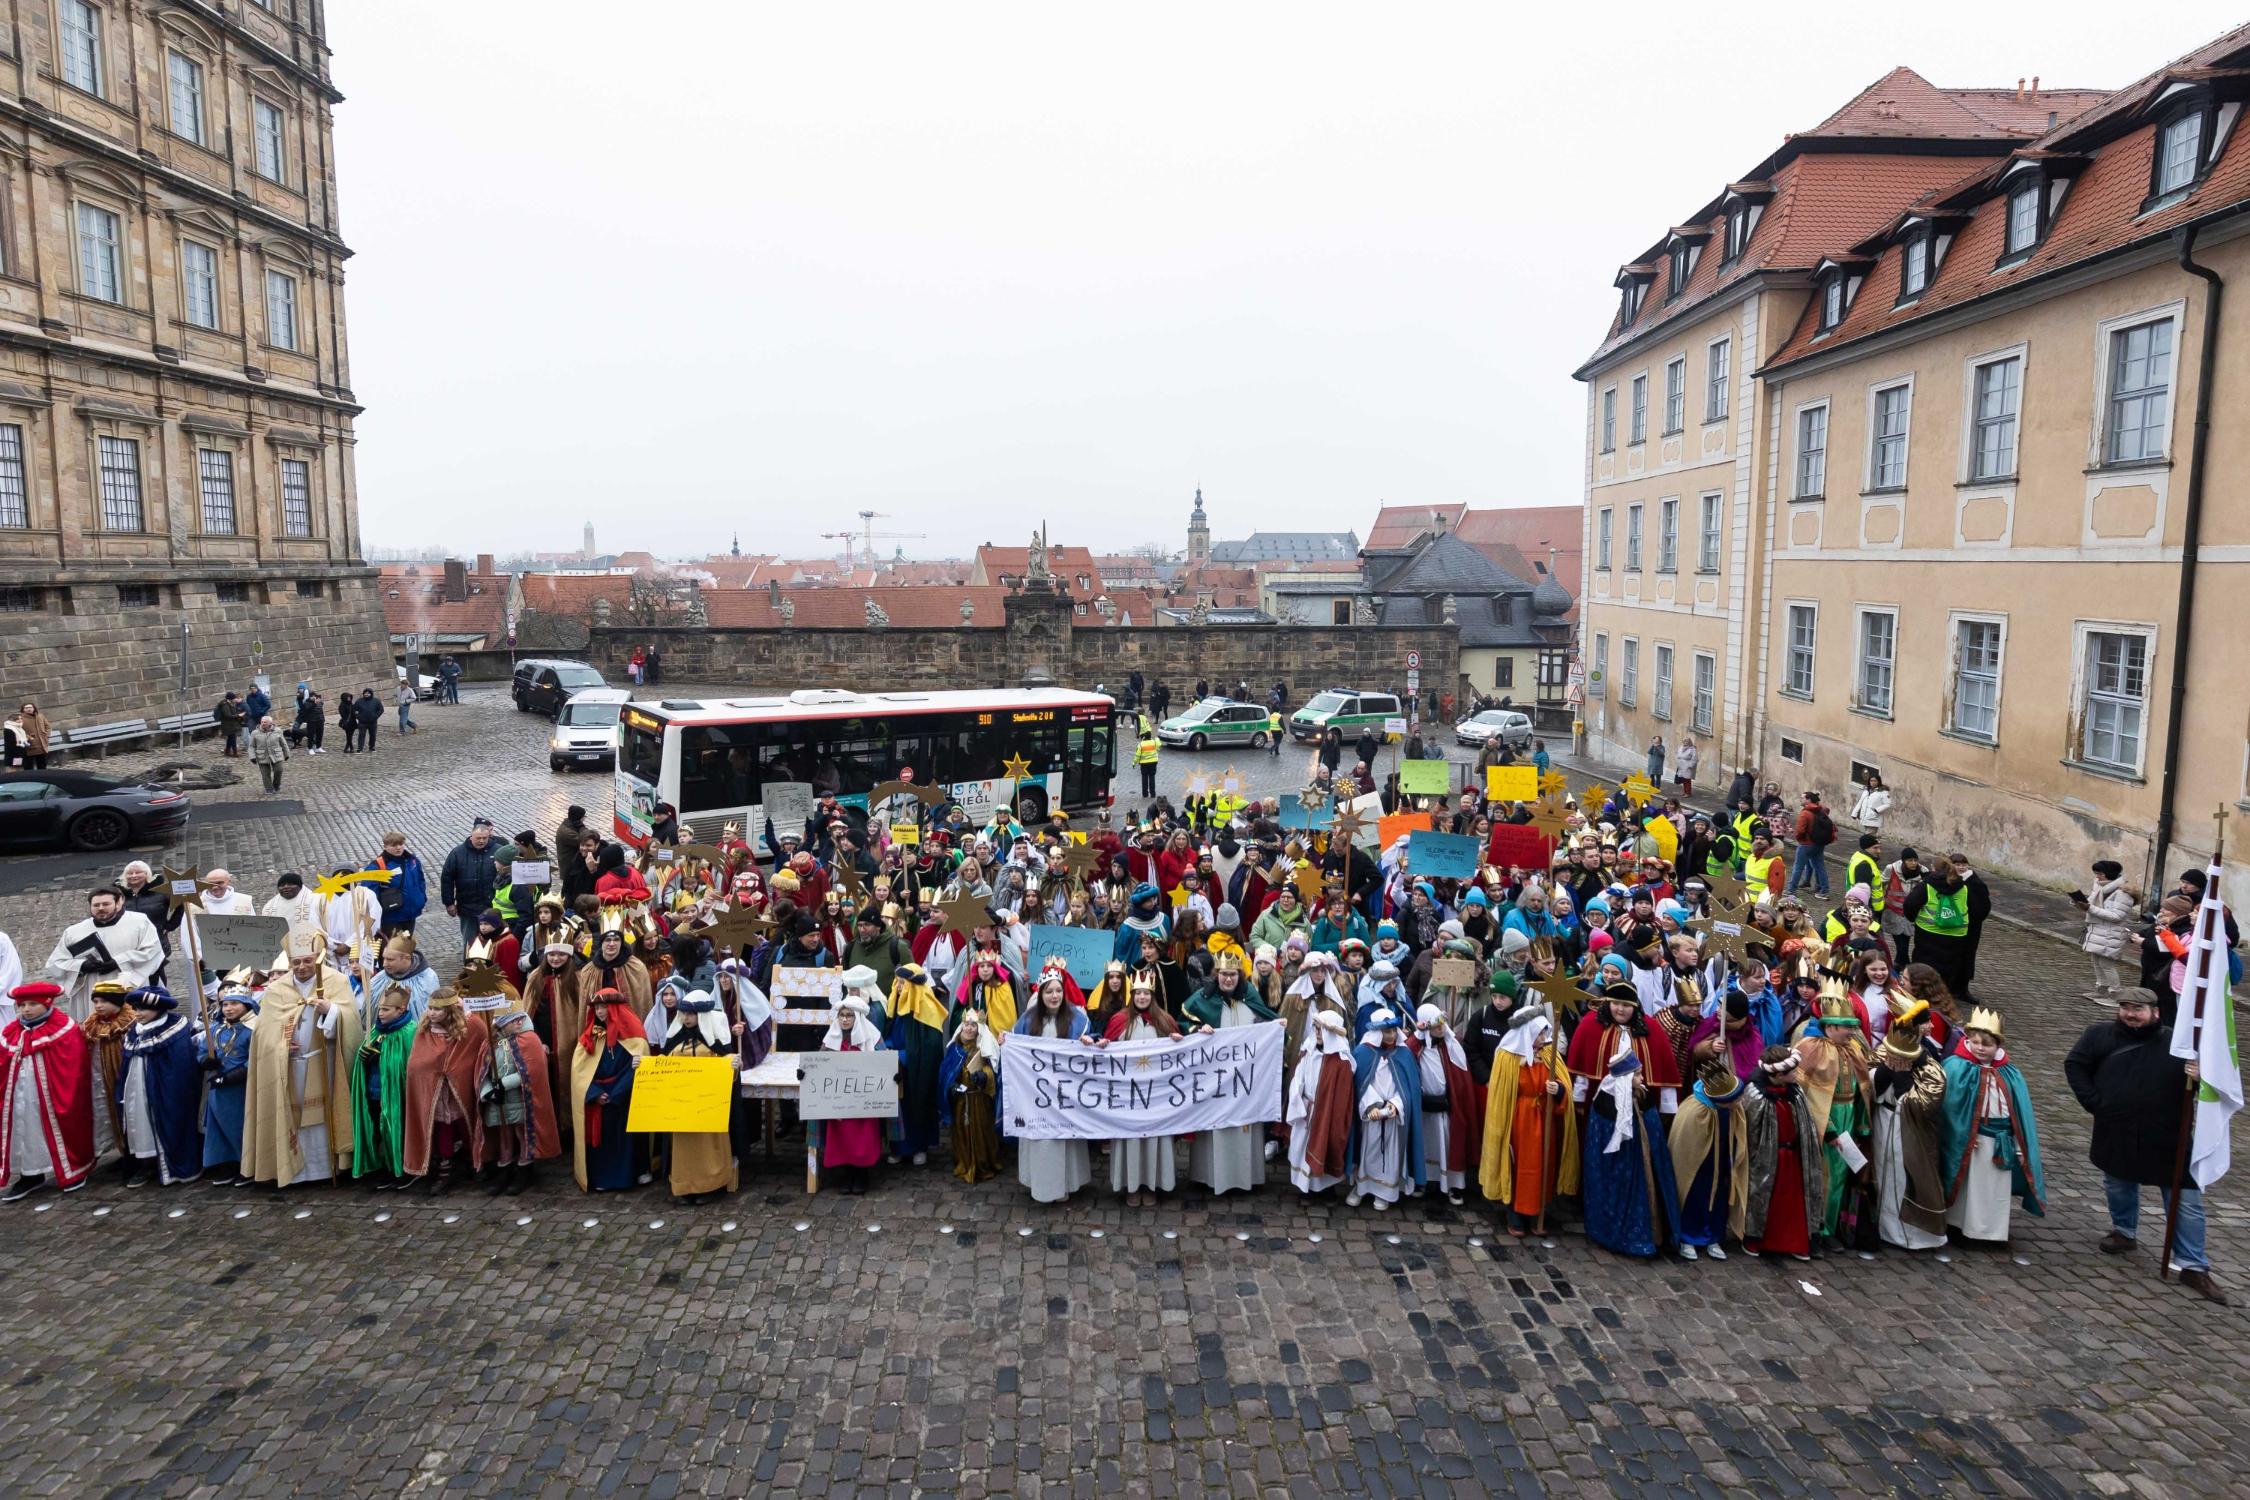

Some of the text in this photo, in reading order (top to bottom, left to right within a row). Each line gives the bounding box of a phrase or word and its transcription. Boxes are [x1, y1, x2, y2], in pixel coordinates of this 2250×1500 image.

[979, 714, 992, 726] 910
[1031, 939, 1087, 959] HOBBYS
[1031, 1042, 1257, 1077] SEGEN BRINGEN
[811, 1075, 888, 1094] SPIELEN
[1034, 1063, 1255, 1110] SEGEN SEIN
